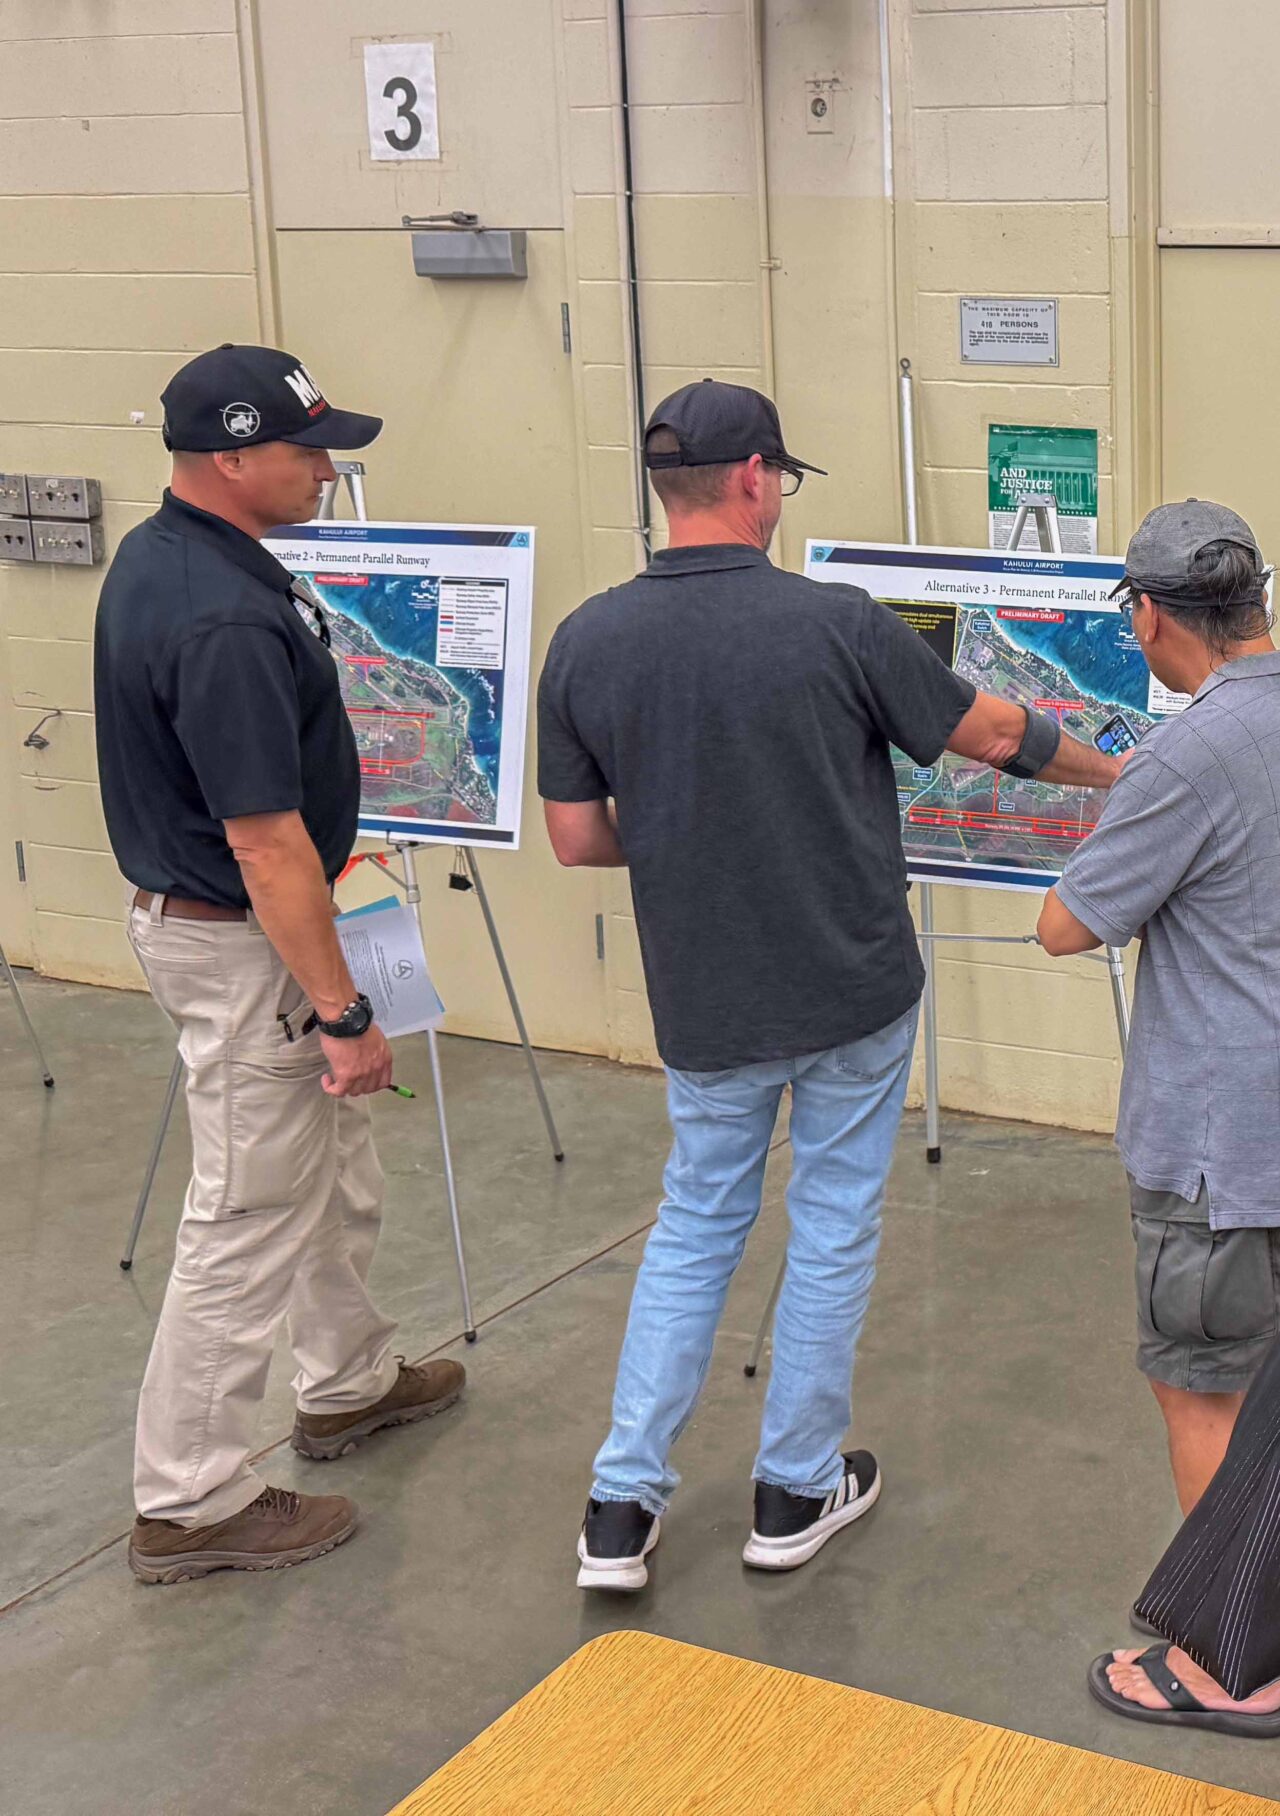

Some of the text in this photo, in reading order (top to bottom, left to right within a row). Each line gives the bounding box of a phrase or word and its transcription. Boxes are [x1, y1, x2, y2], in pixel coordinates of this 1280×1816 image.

[383, 76, 422, 151] 3
[1000, 320, 1039, 328] PERSONS
[1000, 468, 1027, 478] AND
[1000, 478, 1053, 491] JUSTICE
[274, 551, 300, 561] native
[302, 552, 309, 561] 2
[316, 552, 361, 563] Permanent
[363, 553, 394, 564] Parallel
[396, 554, 431, 569] Runway
[1003, 560, 1033, 568] KAHULUI
[924, 580, 982, 595] Alternative
[983, 584, 989, 595] 3
[1000, 585, 1055, 599] Permanent
[1058, 588, 1096, 602] Parallel
[1000, 610, 1061, 621] PRELIMINARY DRAFT
